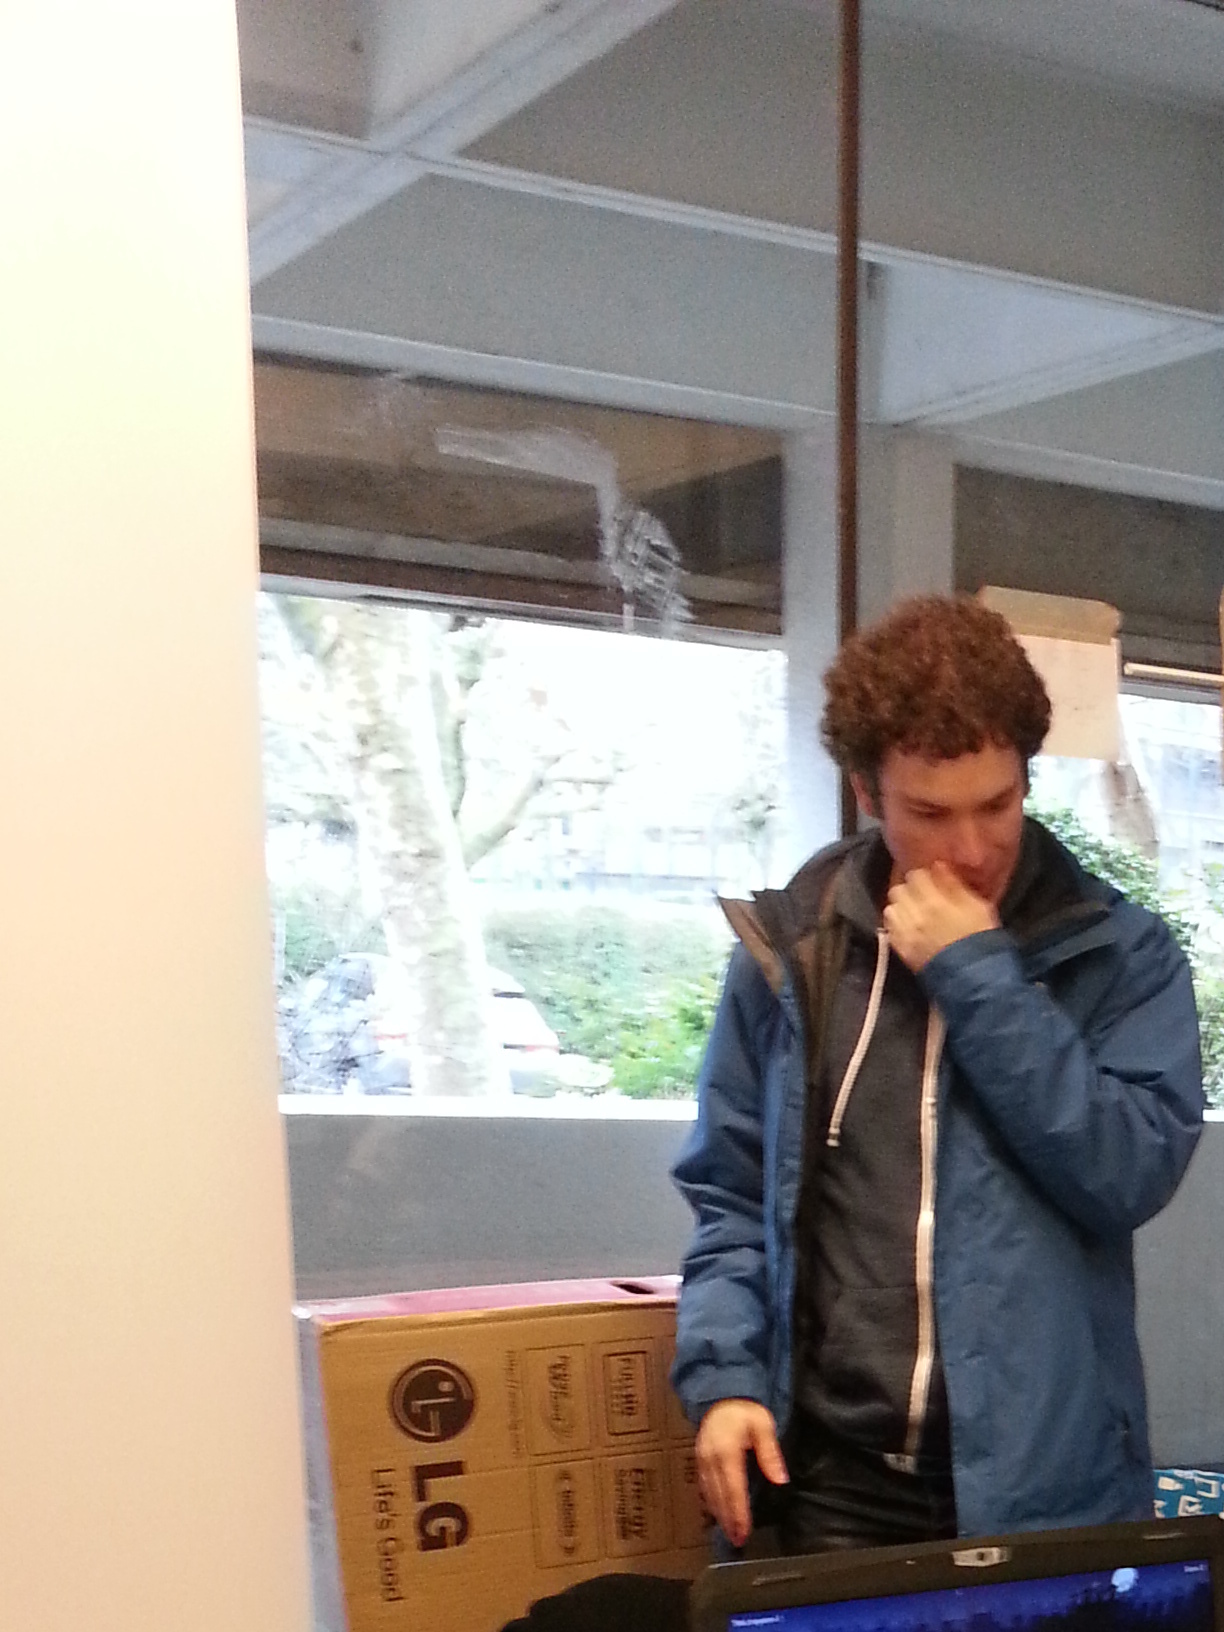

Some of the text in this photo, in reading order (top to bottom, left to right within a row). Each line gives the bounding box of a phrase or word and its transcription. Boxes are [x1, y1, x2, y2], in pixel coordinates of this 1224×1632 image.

[370, 1467, 407, 1602] Life's Good
[411, 1460, 469, 1552] LG
